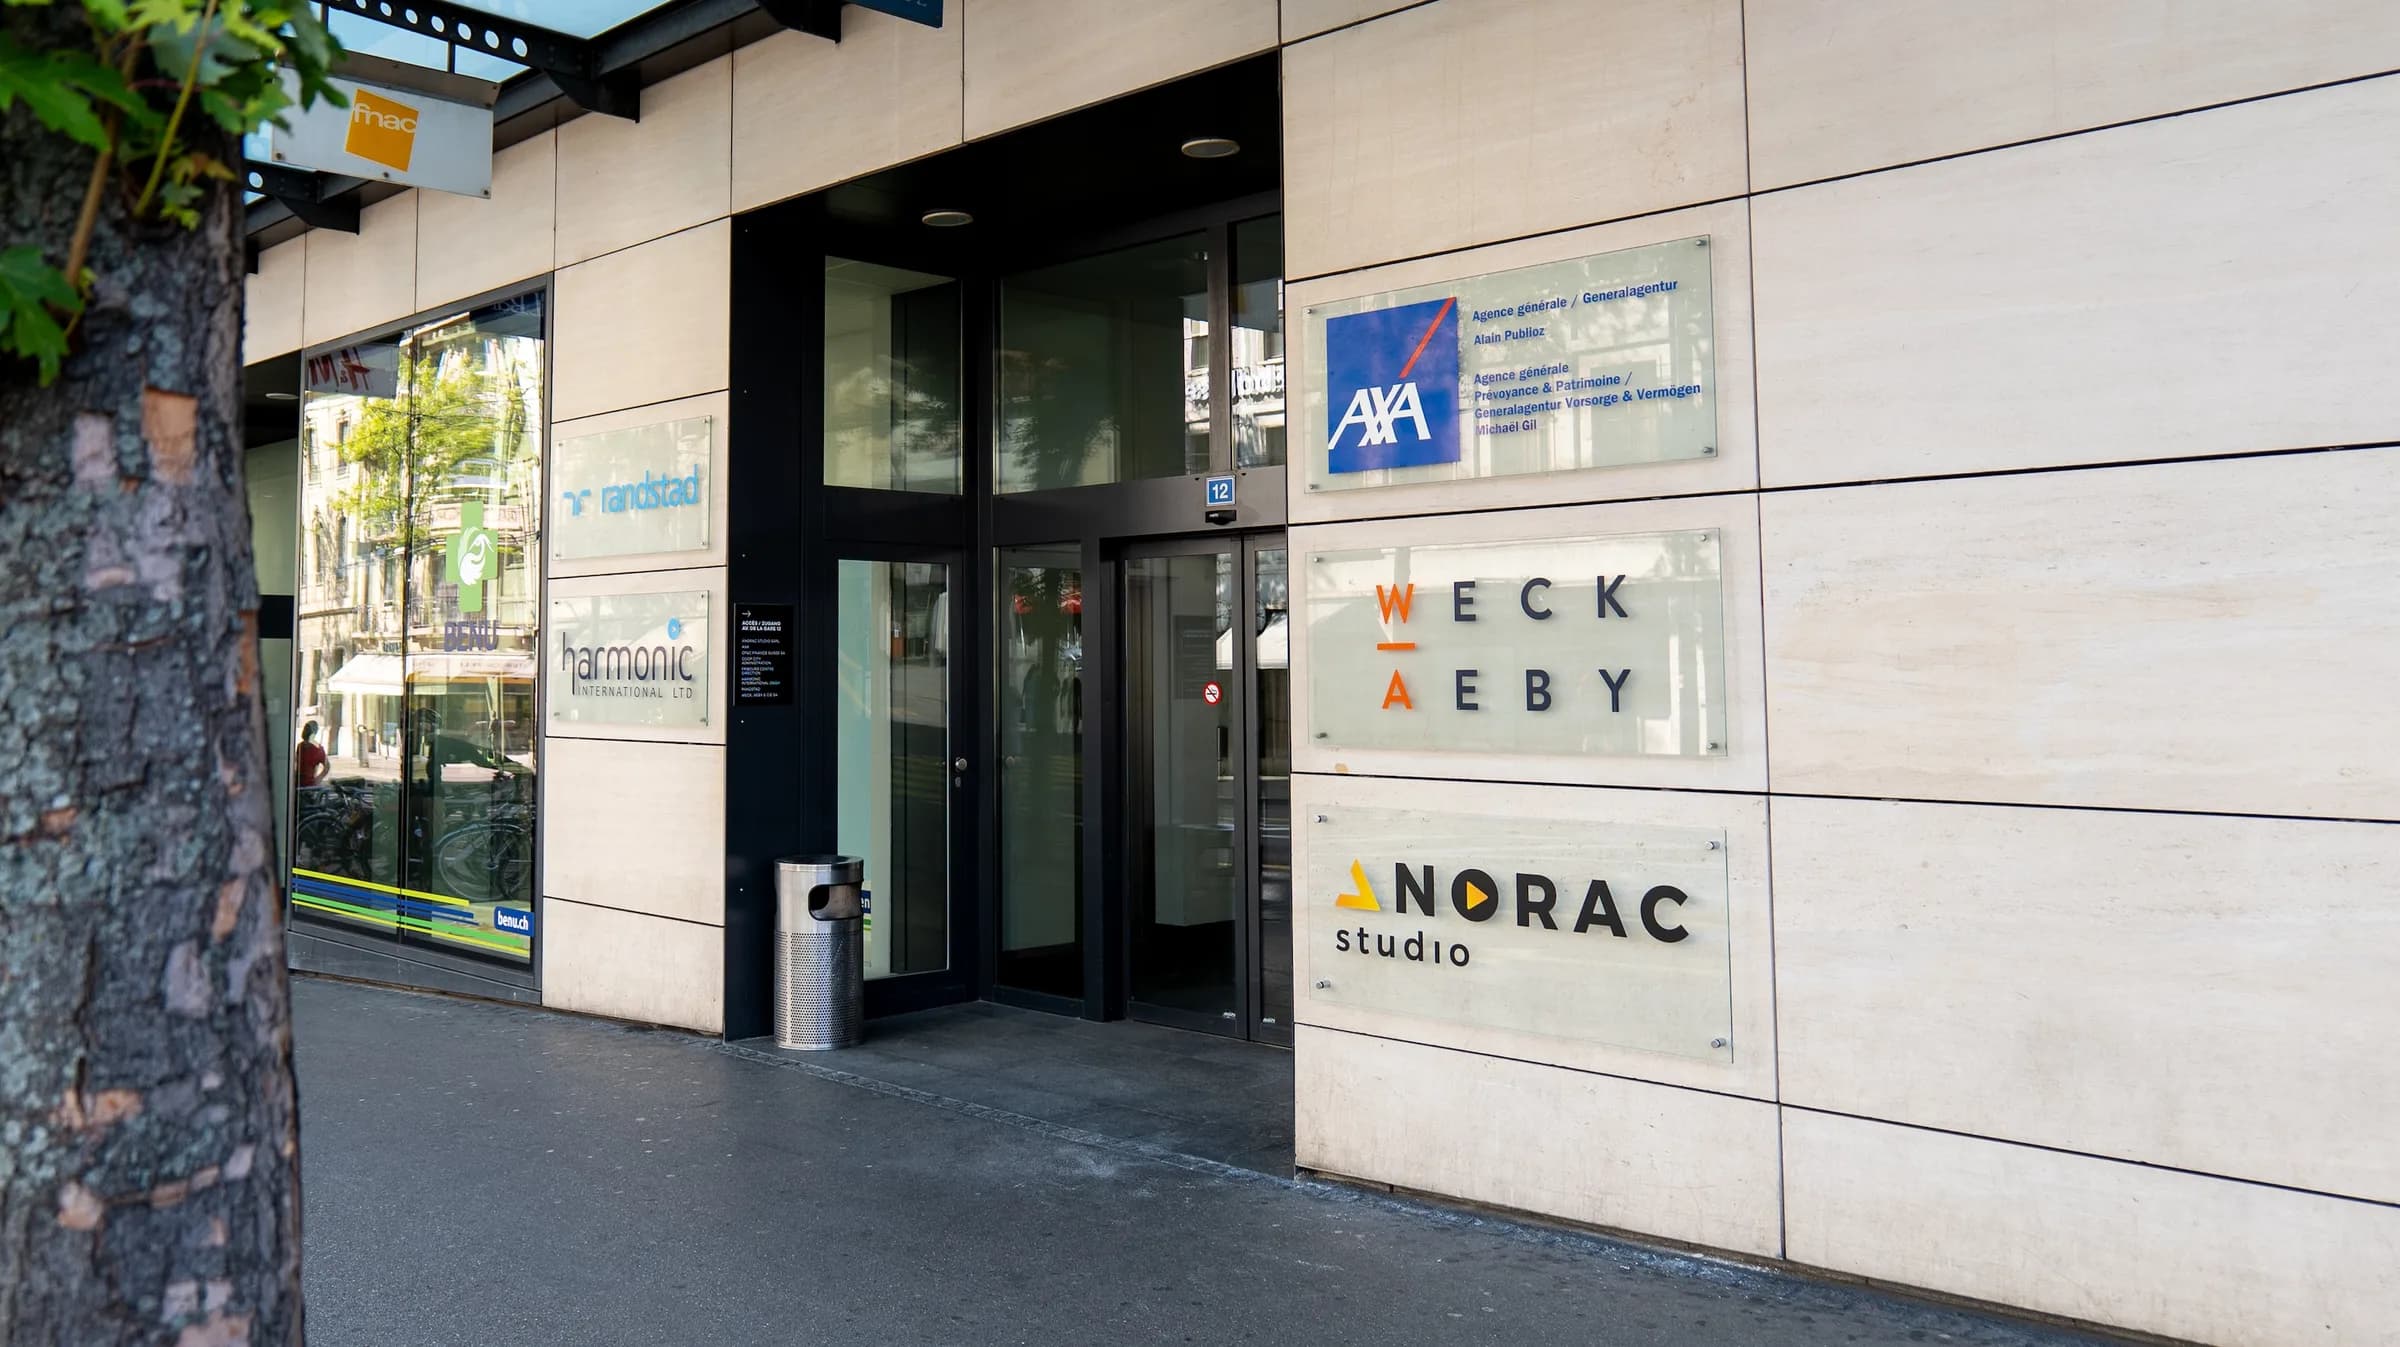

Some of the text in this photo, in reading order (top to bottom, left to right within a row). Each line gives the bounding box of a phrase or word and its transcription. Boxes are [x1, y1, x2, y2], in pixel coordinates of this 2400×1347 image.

[352, 102, 417, 134] fnac
[1472, 279, 1678, 323] Agence générale / Generalagentur
[1473, 326, 1545, 346] Alain Publioz
[1473, 362, 1569, 387] Agence générale
[1474, 371, 1633, 401] Prévoyance & Patrimoine /
[1327, 382, 1432, 451] AXA
[1474, 383, 1701, 420] Generalagentur Vorsorge & Vermögen
[1475, 419, 1537, 436] Michaël Gil
[601, 463, 699, 513] randstad
[1212, 482, 1229, 500] 12
[1376, 573, 1629, 625] WECK
[444, 620, 499, 652] BENU
[562, 617, 693, 695] harmonic
[577, 685, 693, 699] INTERNATIONAL LTD
[1382, 668, 1632, 713] AEBY
[497, 910, 529, 931] benu.ch
[1335, 926, 1470, 967] studio
